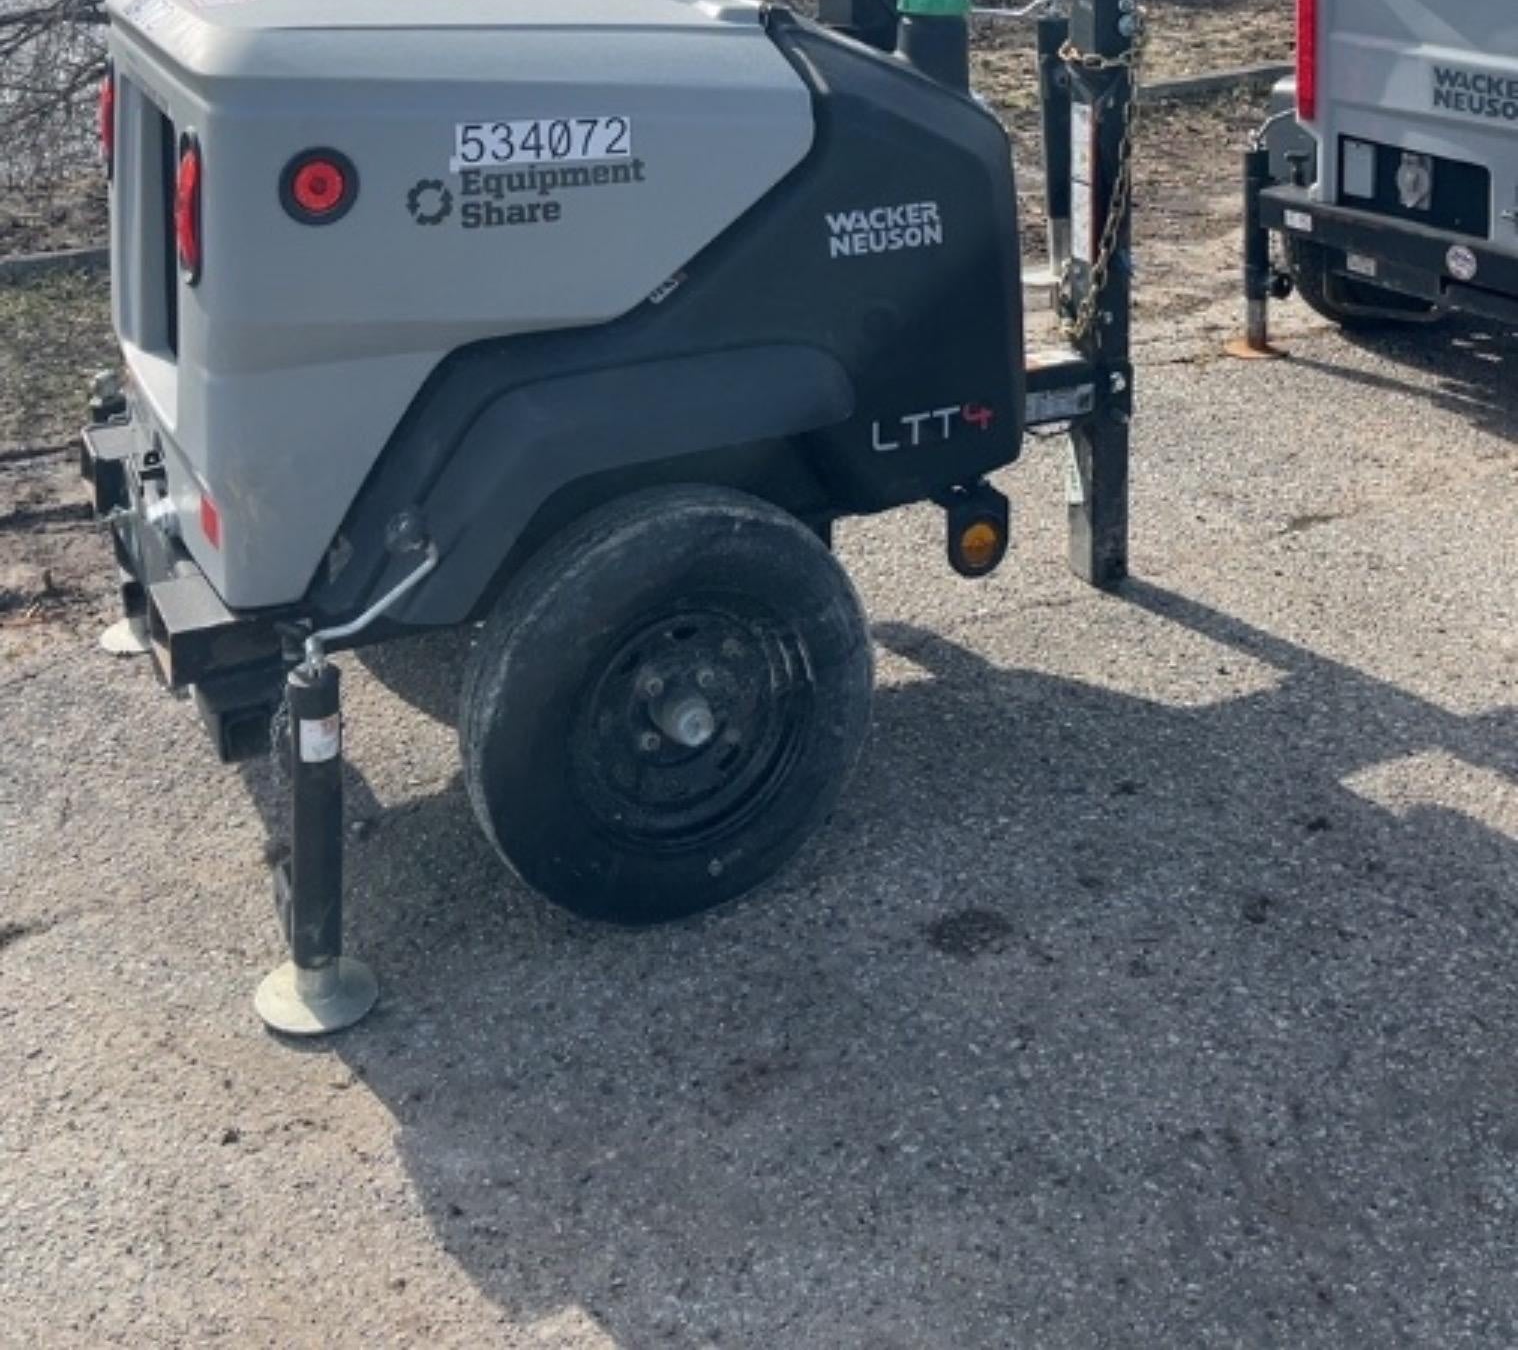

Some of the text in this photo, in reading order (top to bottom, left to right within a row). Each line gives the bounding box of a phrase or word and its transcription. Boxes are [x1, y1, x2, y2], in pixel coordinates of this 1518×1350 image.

[460, 116, 628, 163] 534072
[459, 158, 646, 199] Equipment
[460, 201, 561, 229] Share
[824, 200, 940, 235] WACKER
[829, 223, 943, 258] NEUSON
[871, 404, 993, 451] LTT4
